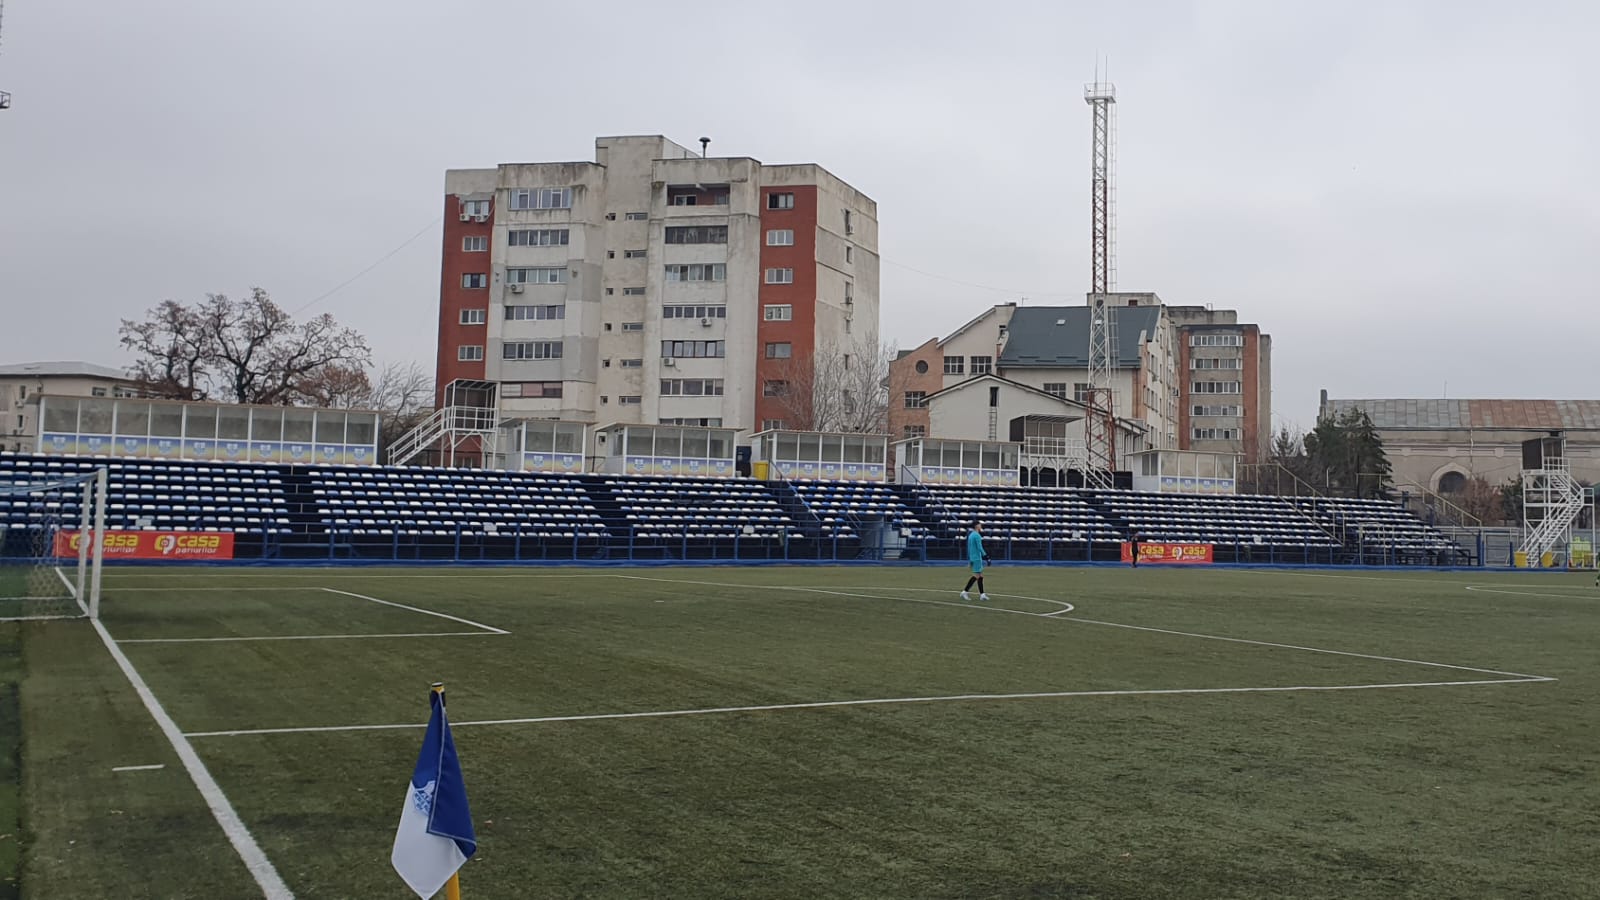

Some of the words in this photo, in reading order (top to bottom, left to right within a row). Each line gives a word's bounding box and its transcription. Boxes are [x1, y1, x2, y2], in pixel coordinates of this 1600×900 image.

[98, 534, 138, 547] asa
[177, 535, 220, 548] casa
[1140, 545, 1165, 555] casa
[1183, 546, 1206, 555] casa
